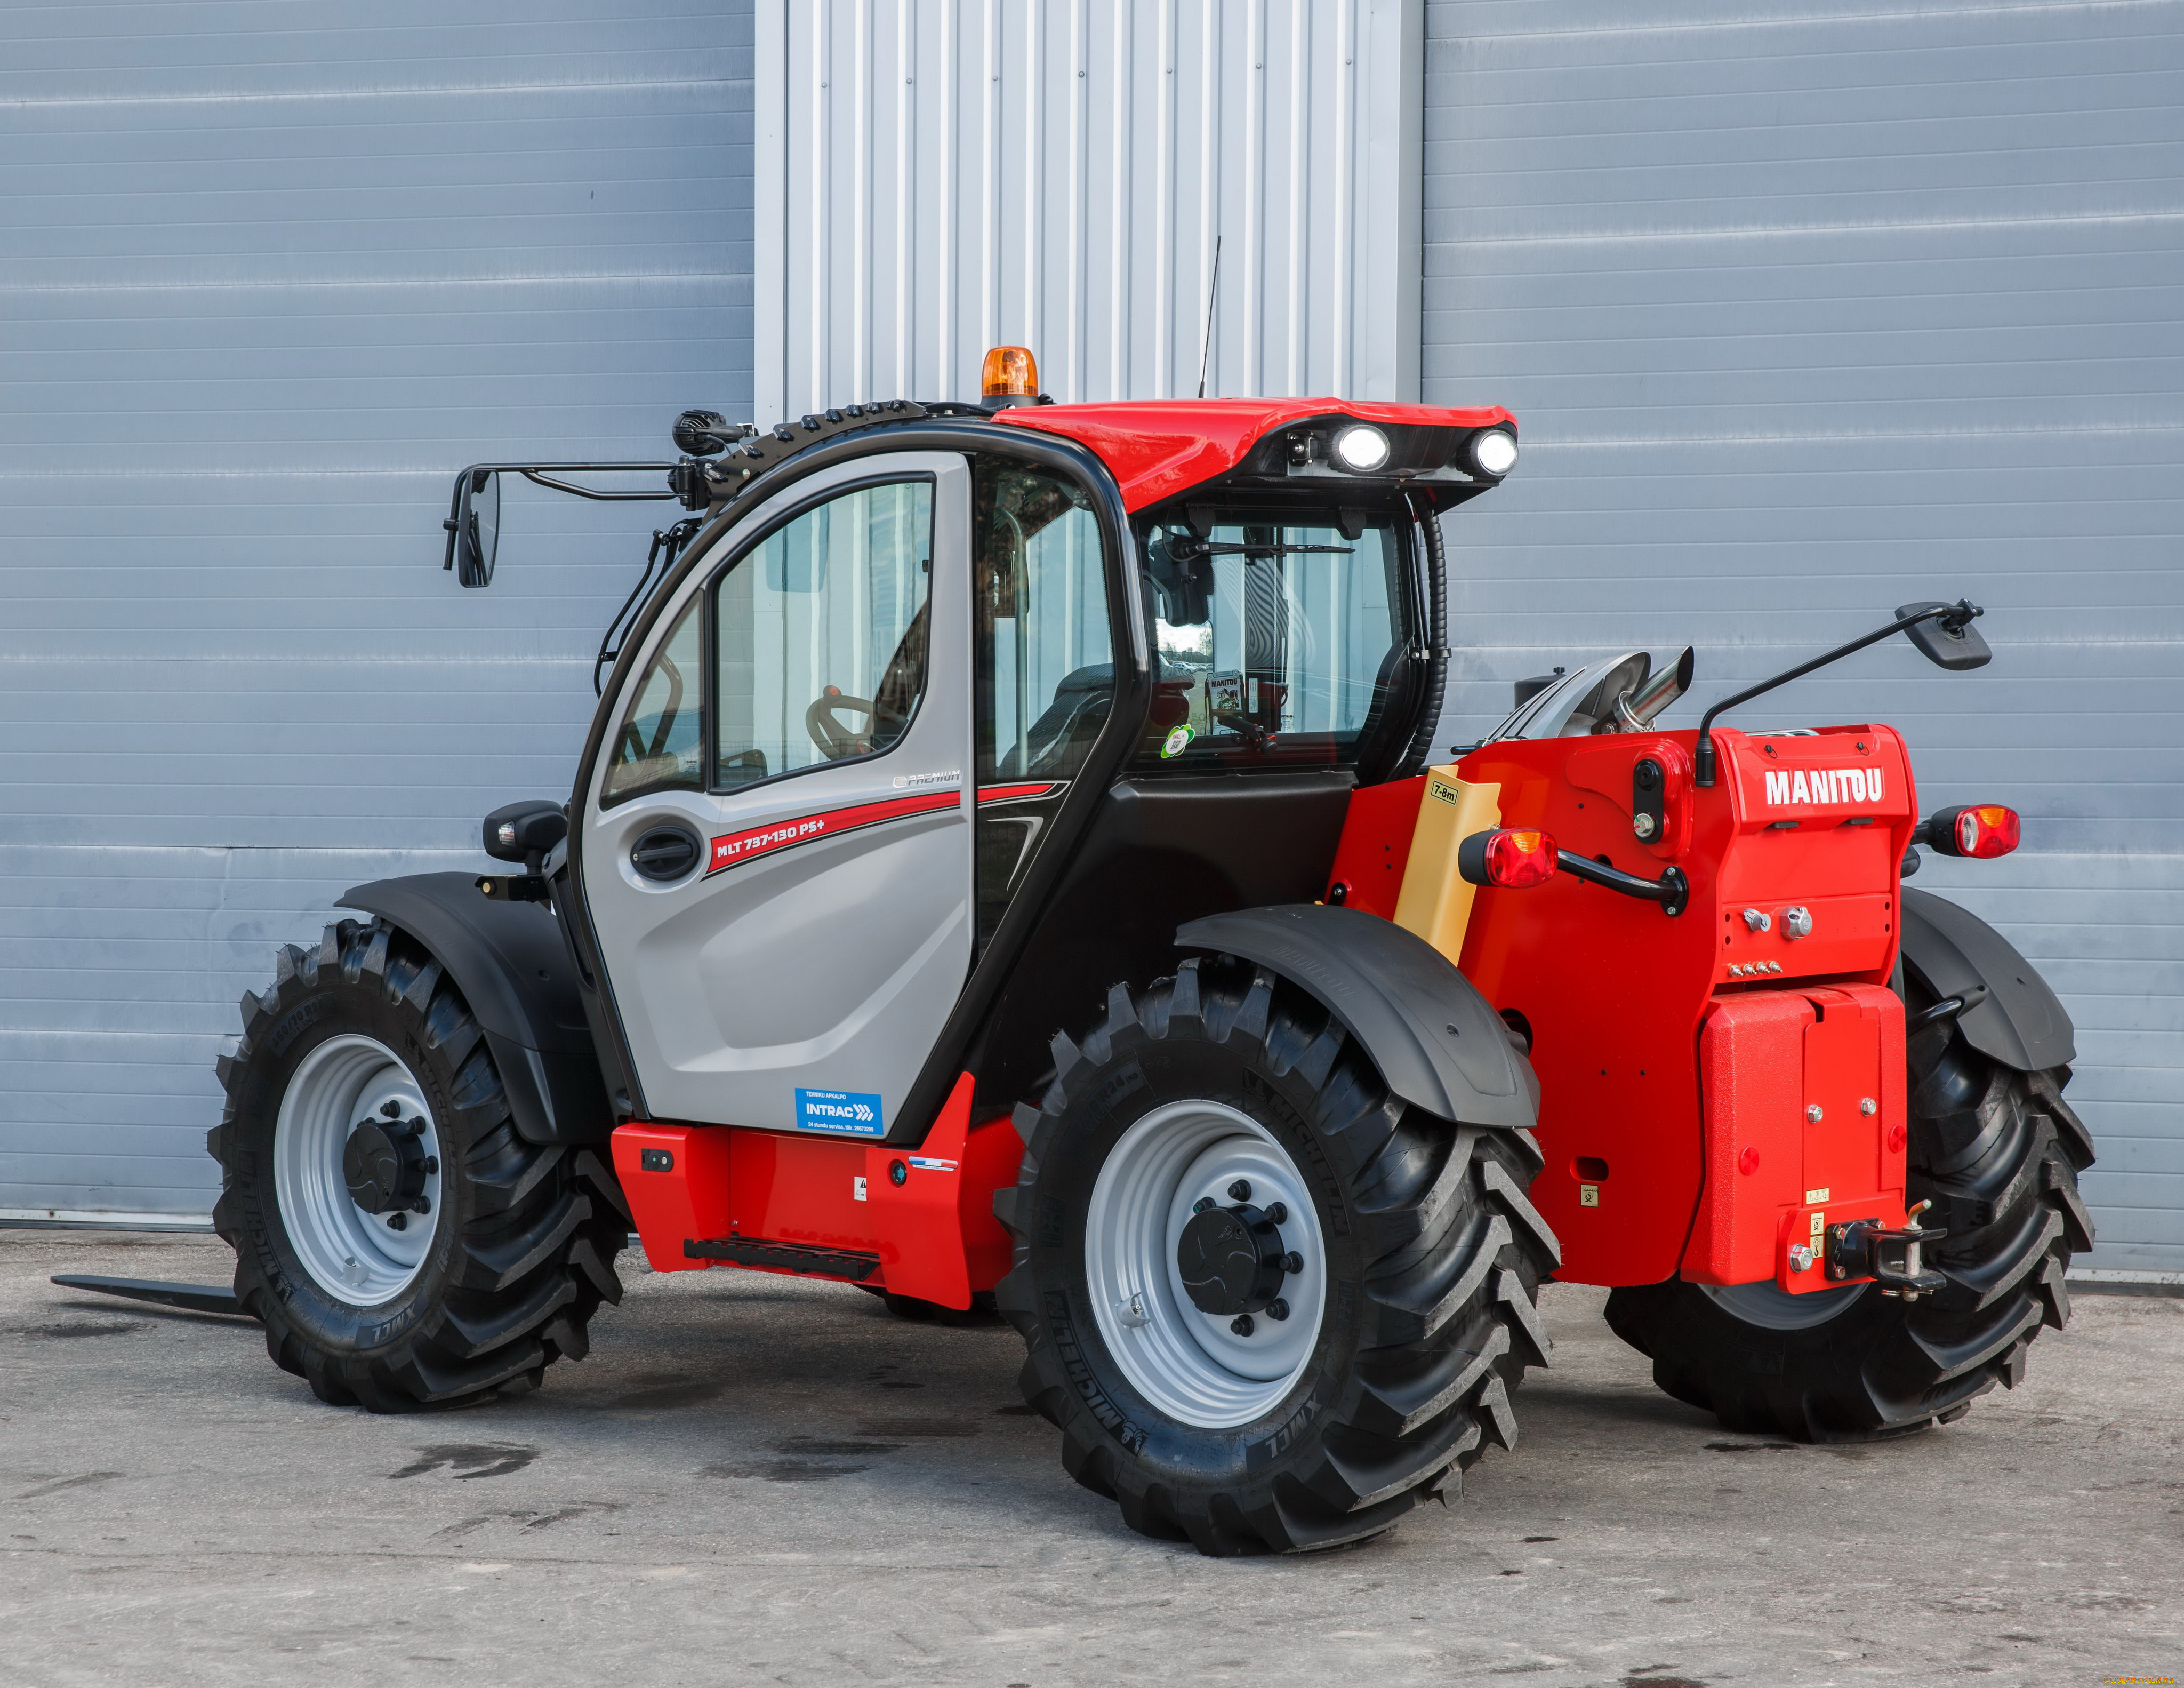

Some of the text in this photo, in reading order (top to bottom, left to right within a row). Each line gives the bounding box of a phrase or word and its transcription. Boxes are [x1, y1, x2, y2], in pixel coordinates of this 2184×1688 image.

[1211, 678, 1238, 687] MANITOU
[908, 770, 961, 786] PREMIUM
[1765, 768, 1883, 805] MANITOU
[1435, 784, 1455, 801] 7-8m
[717, 820, 825, 858] MLT 737-130 PS+
[806, 1103, 854, 1118] INTRAC
[372, 1301, 417, 1343] XMCL
[1265, 1391, 1323, 1459] XMCL
